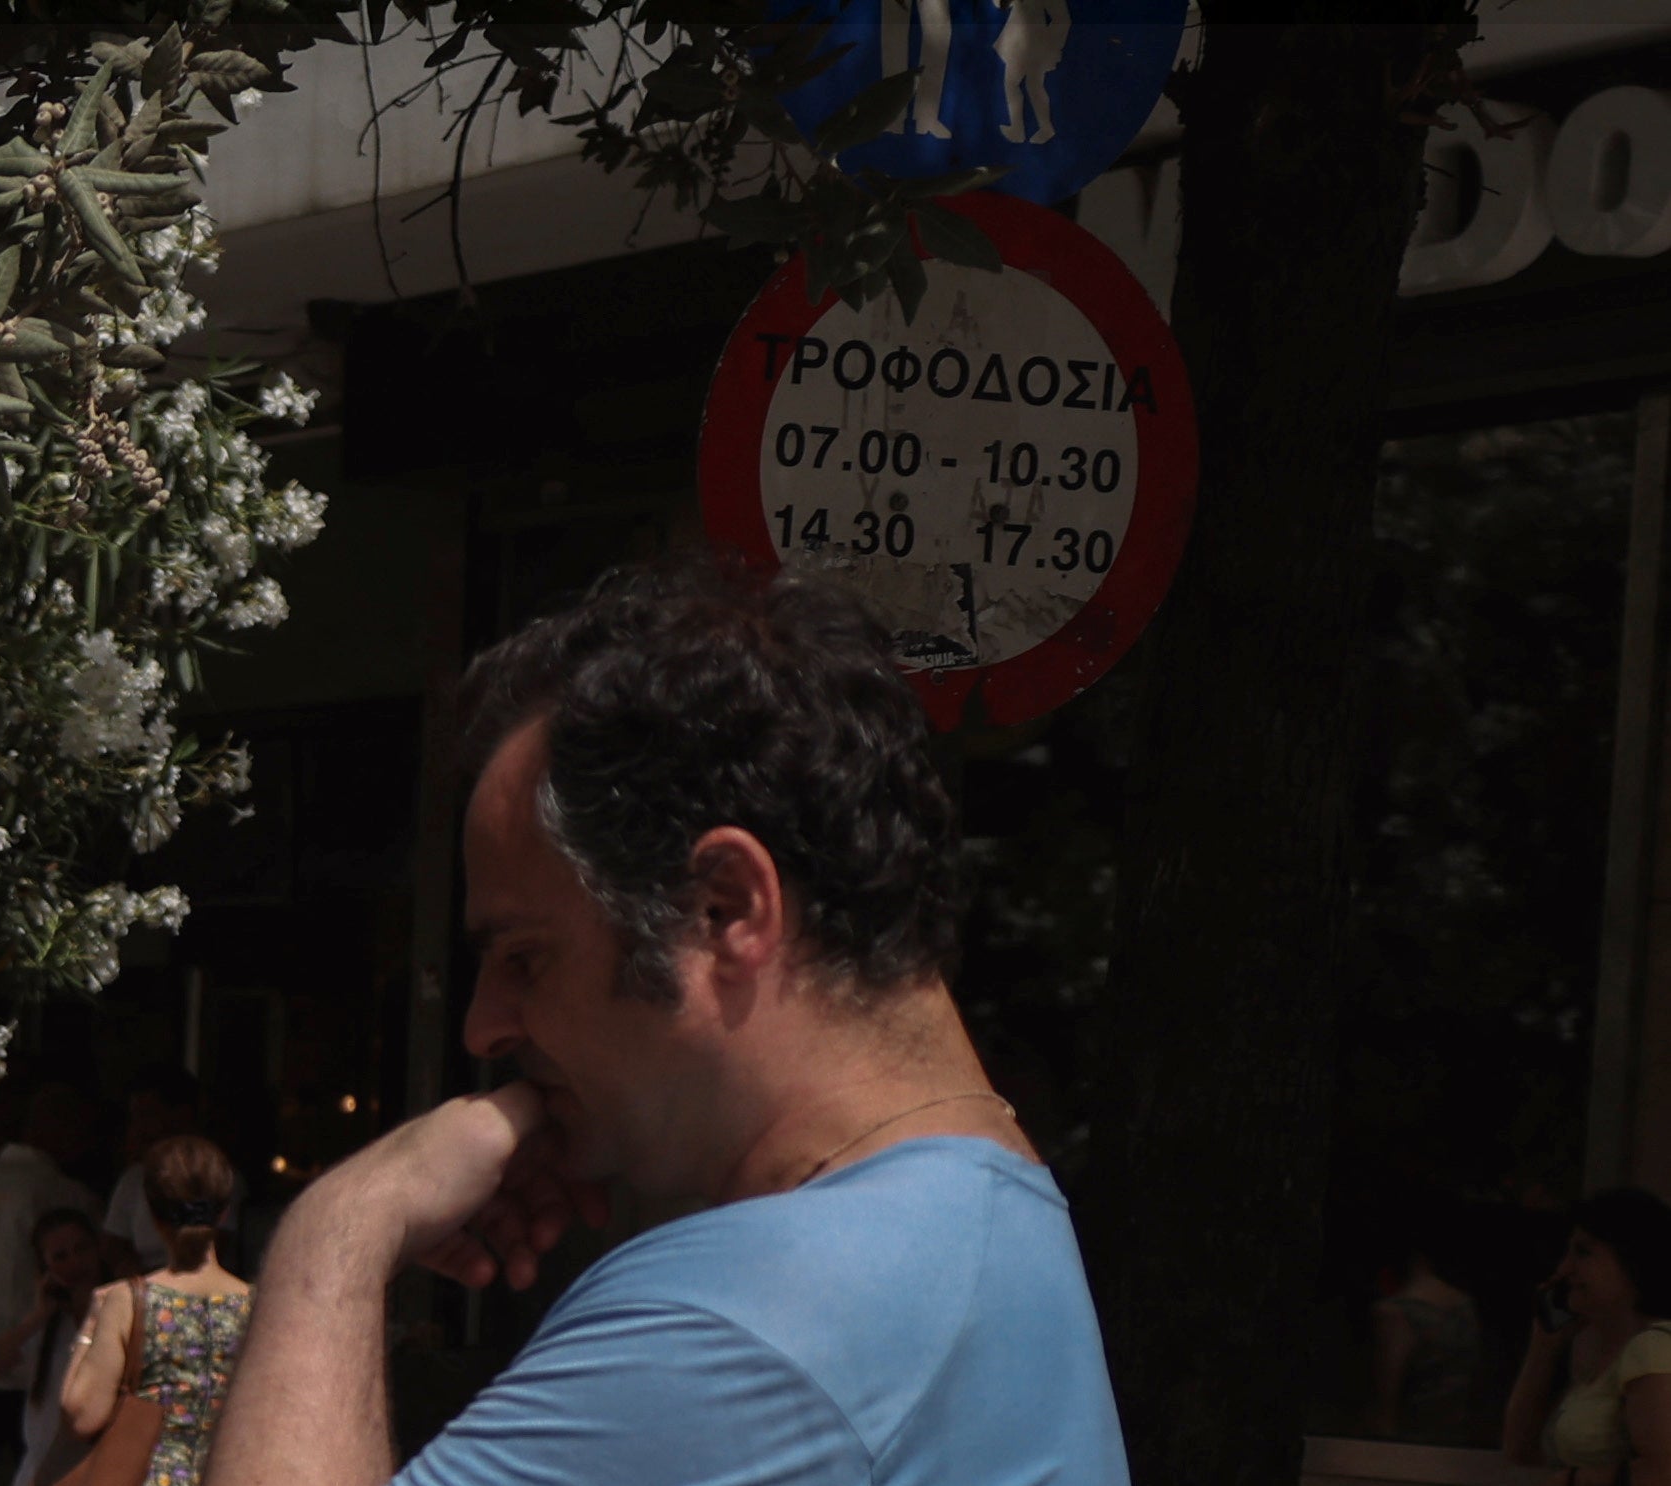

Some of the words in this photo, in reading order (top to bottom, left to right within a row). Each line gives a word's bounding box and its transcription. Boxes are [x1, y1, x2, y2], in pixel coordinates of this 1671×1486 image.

[756, 333, 1159, 414] ΤΡΟΦΟΔΟΣΙΑ
[775, 423, 921, 477] 07.00
[983, 439, 1122, 493] 10.30
[774, 503, 915, 558] 14.30
[975, 521, 1114, 574] 17.30
